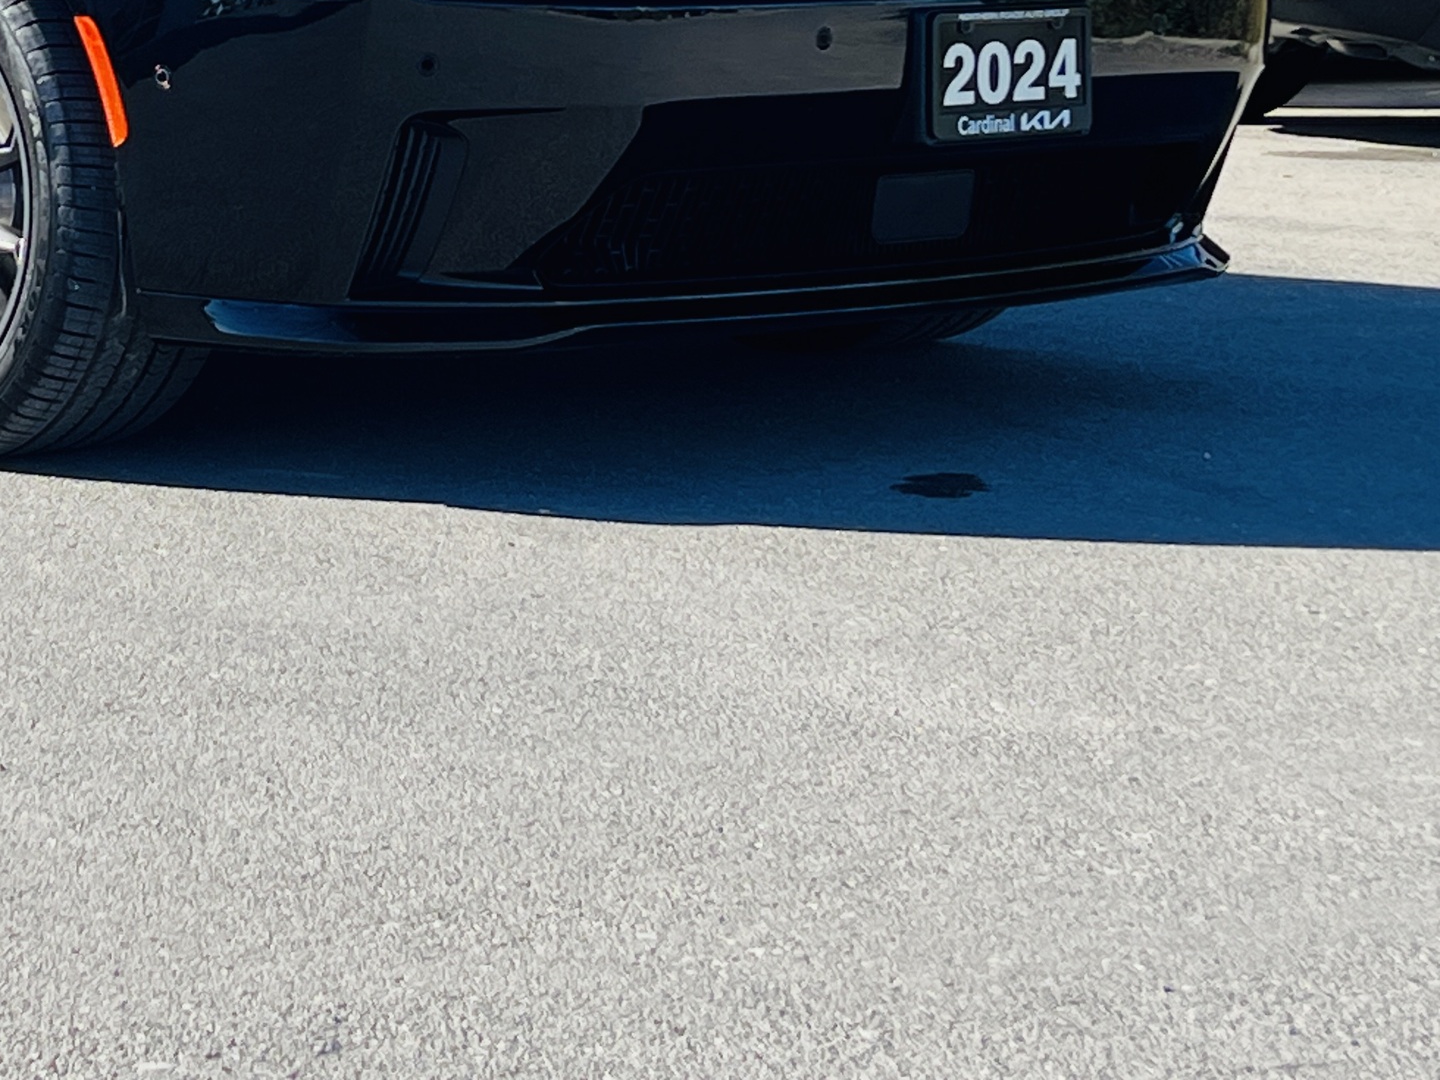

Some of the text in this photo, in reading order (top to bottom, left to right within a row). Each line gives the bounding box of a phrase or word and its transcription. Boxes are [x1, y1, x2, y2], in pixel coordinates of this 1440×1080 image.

[942, 38, 1082, 107] 2024
[957, 109, 1071, 136] Cardinal KIA
